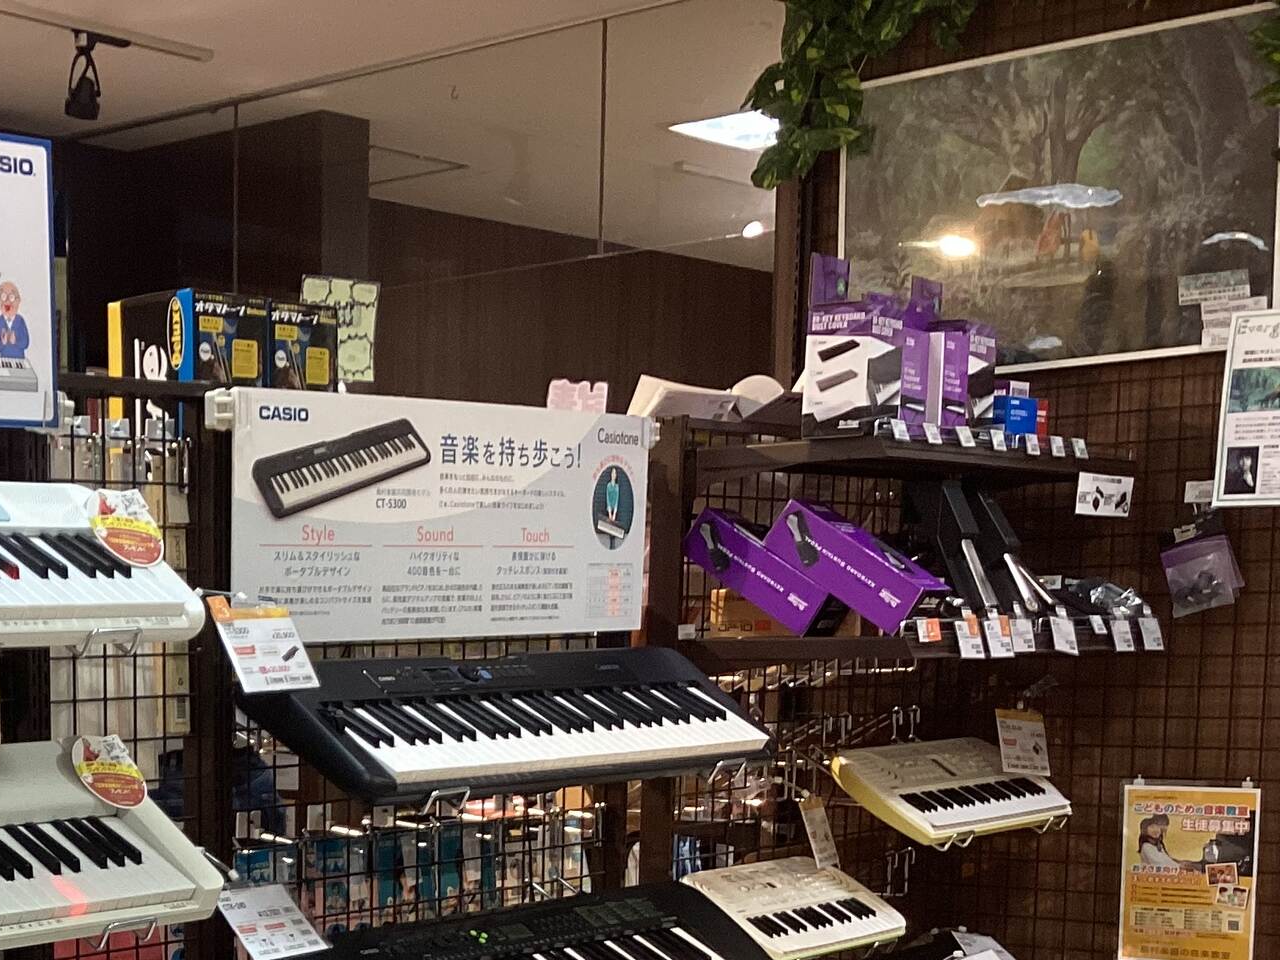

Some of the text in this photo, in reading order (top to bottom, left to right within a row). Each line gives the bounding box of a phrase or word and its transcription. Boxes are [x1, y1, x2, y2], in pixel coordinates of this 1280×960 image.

[195, 300, 245, 317] オタマトーン
[271, 309, 318, 325] オタマトーン
[259, 405, 309, 422] CASIO
[597, 427, 639, 447] Casiotone
[440, 433, 582, 469] 音楽を持ち歩こう!
[376, 498, 407, 510] CT-S300
[301, 524, 550, 544] Style Sound Touch
[1181, 818, 1251, 835] 生徒募集中
